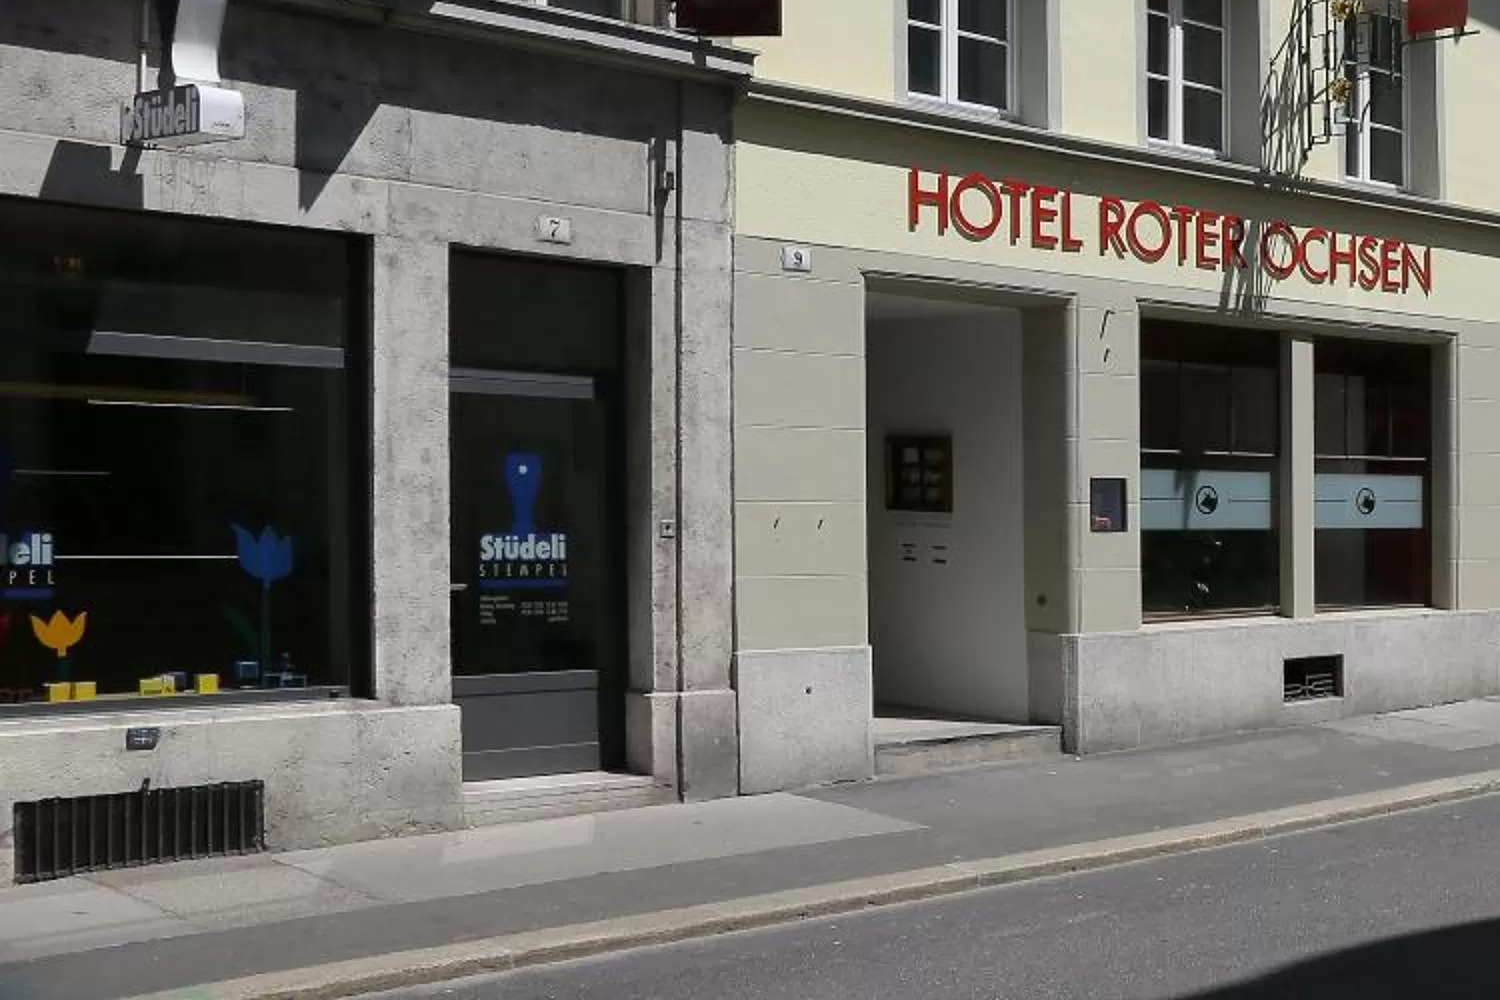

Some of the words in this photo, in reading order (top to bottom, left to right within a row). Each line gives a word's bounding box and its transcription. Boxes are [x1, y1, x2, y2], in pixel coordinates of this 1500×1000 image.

[133, 87, 198, 140] Stüdeli
[549, 219, 559, 238] 7
[908, 166, 1083, 251] HOTEL
[1099, 195, 1248, 271] ROTER
[1260, 219, 1431, 297] OCHSEN
[792, 251, 804, 265] 9
[480, 533, 567, 561] Stüdeli
